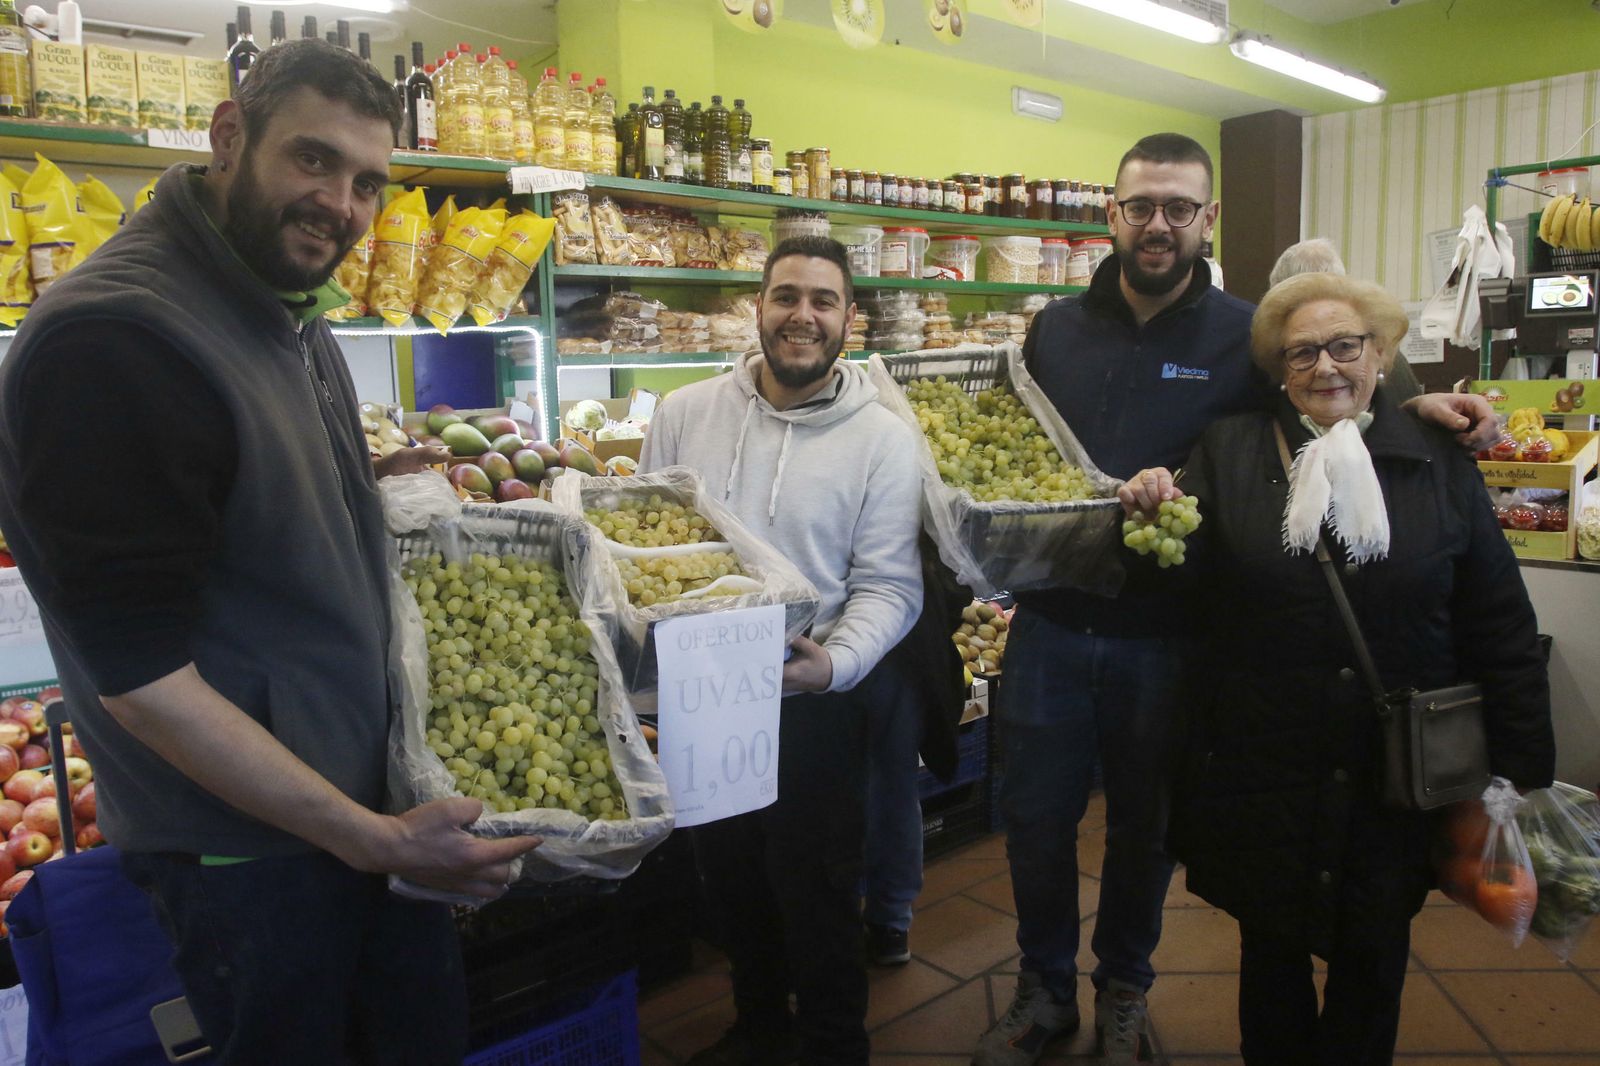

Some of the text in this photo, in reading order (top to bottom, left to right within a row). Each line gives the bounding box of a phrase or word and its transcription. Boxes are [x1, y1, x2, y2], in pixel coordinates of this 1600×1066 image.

[45, 44, 71, 55] Gran
[37, 52, 80, 65] DUQUE
[97, 51, 124, 62] Gran
[148, 55, 172, 65] Gran
[91, 60, 132, 72] DUQUE
[141, 63, 180, 76] DUQUE
[195, 61, 218, 71] Gran
[189, 69, 224, 81] DUQUE
[160, 130, 203, 147] VINO
[677, 620, 775, 651] OFERTON
[675, 665, 778, 714] UVAS
[681, 730, 772, 799] 1,00
